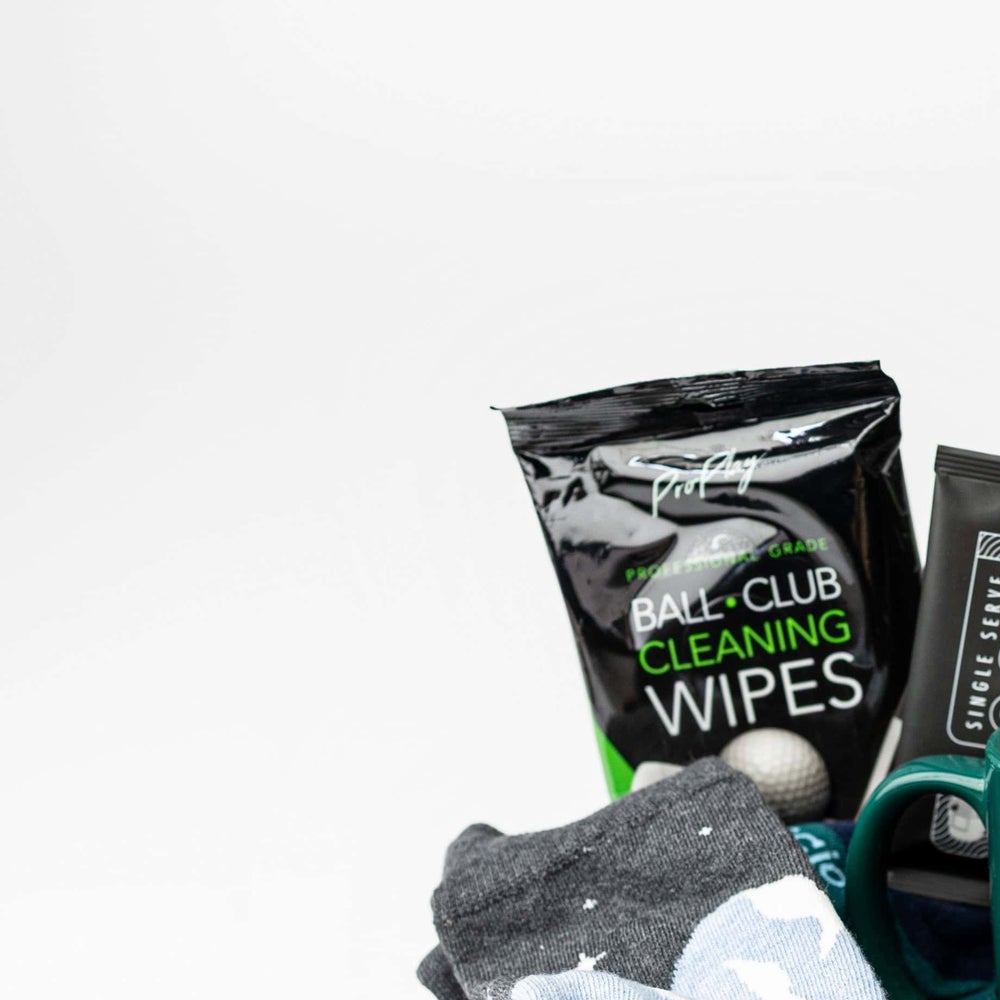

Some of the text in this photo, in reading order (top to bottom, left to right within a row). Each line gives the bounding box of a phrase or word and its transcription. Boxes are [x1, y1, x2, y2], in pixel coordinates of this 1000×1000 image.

[768, 537, 828, 559] GRADE
[630, 566, 843, 632] BALL CLUB
[638, 609, 852, 675] CLEANING
[645, 652, 864, 737] WIPES
[965, 654, 994, 730] SINGLE
